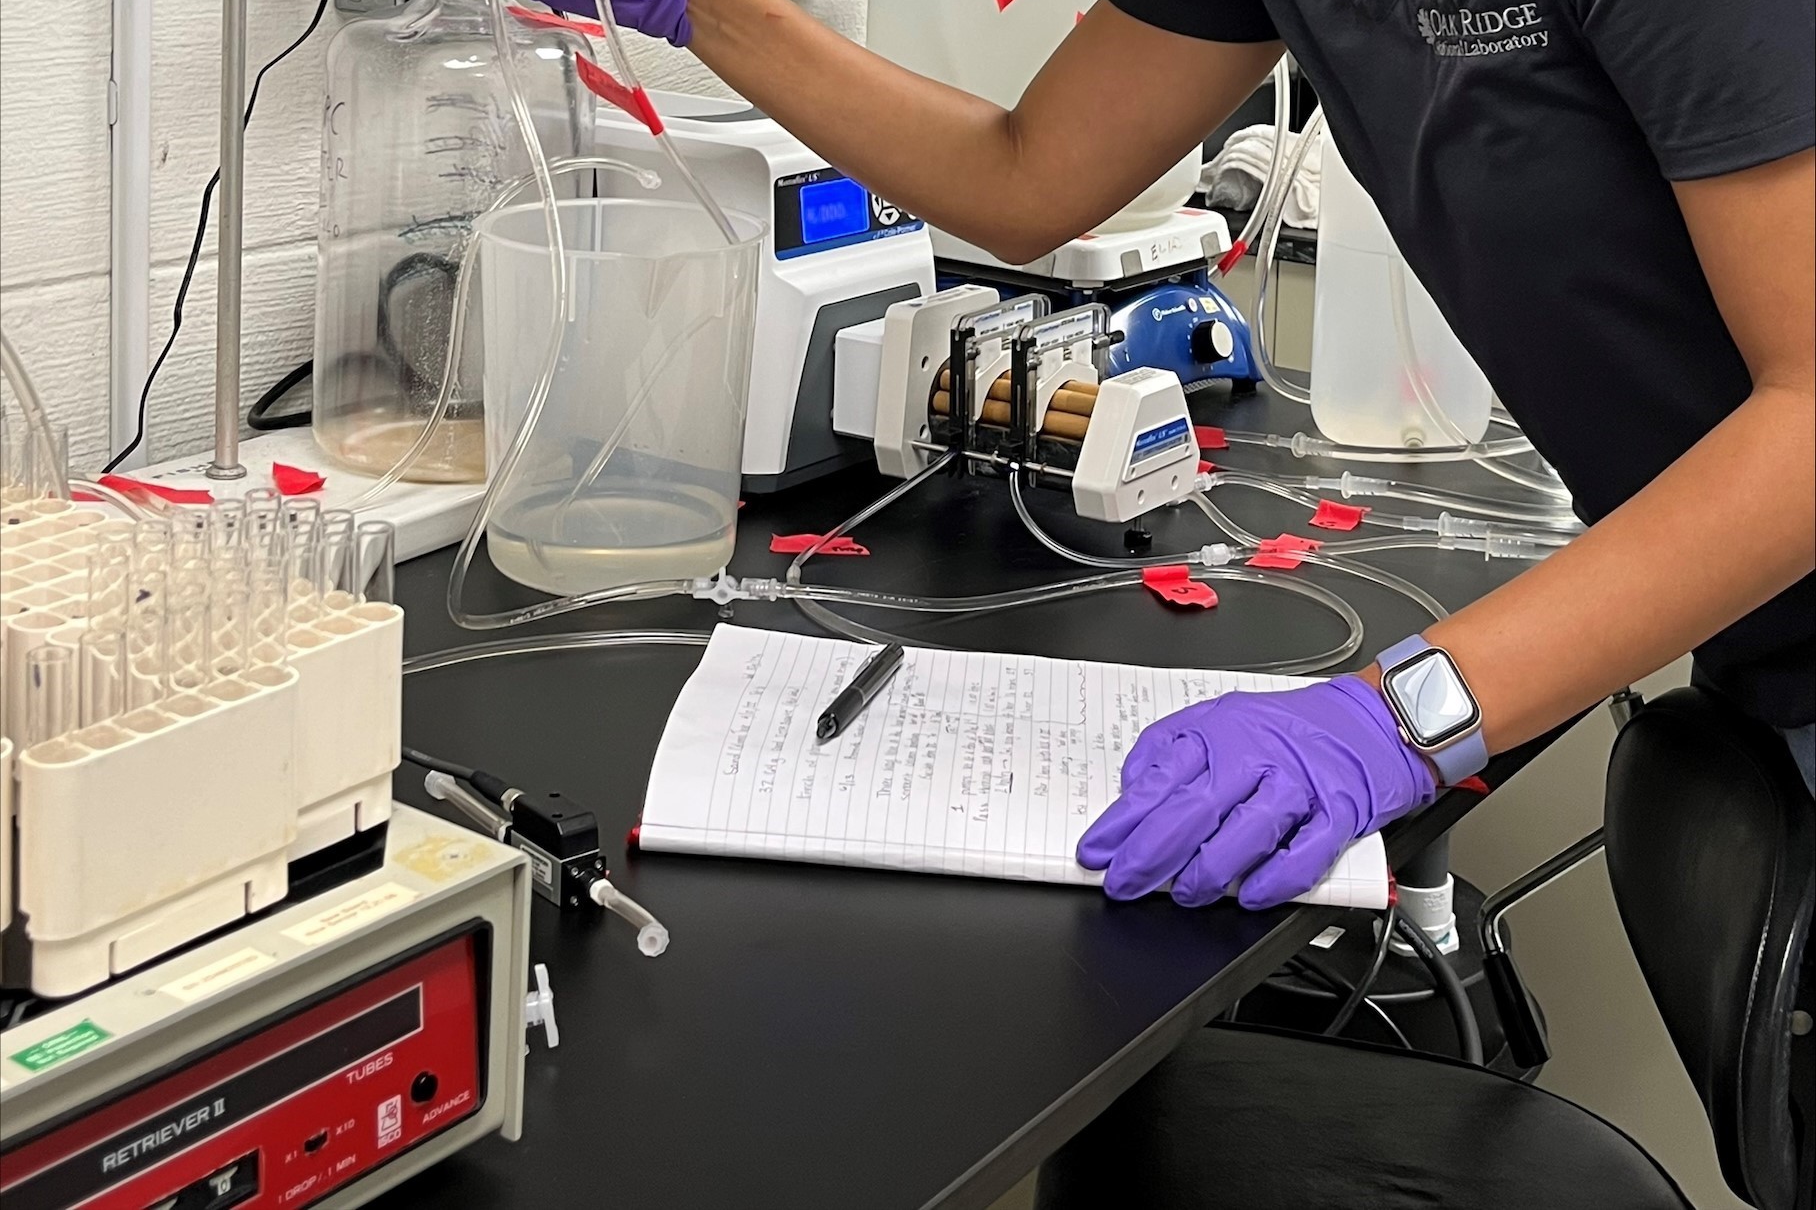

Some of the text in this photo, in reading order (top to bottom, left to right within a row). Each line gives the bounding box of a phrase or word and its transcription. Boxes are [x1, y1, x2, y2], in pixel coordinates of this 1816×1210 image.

[1430, 2, 1543, 37] OAK RIDGE
[1464, 30, 1549, 57] Laboratory
[346, 1052, 394, 1084] TUBES
[422, 1090, 470, 1125] ADVANCE
[102, 1106, 210, 1174] RETRIEVER
[335, 1154, 357, 1172] MIN
